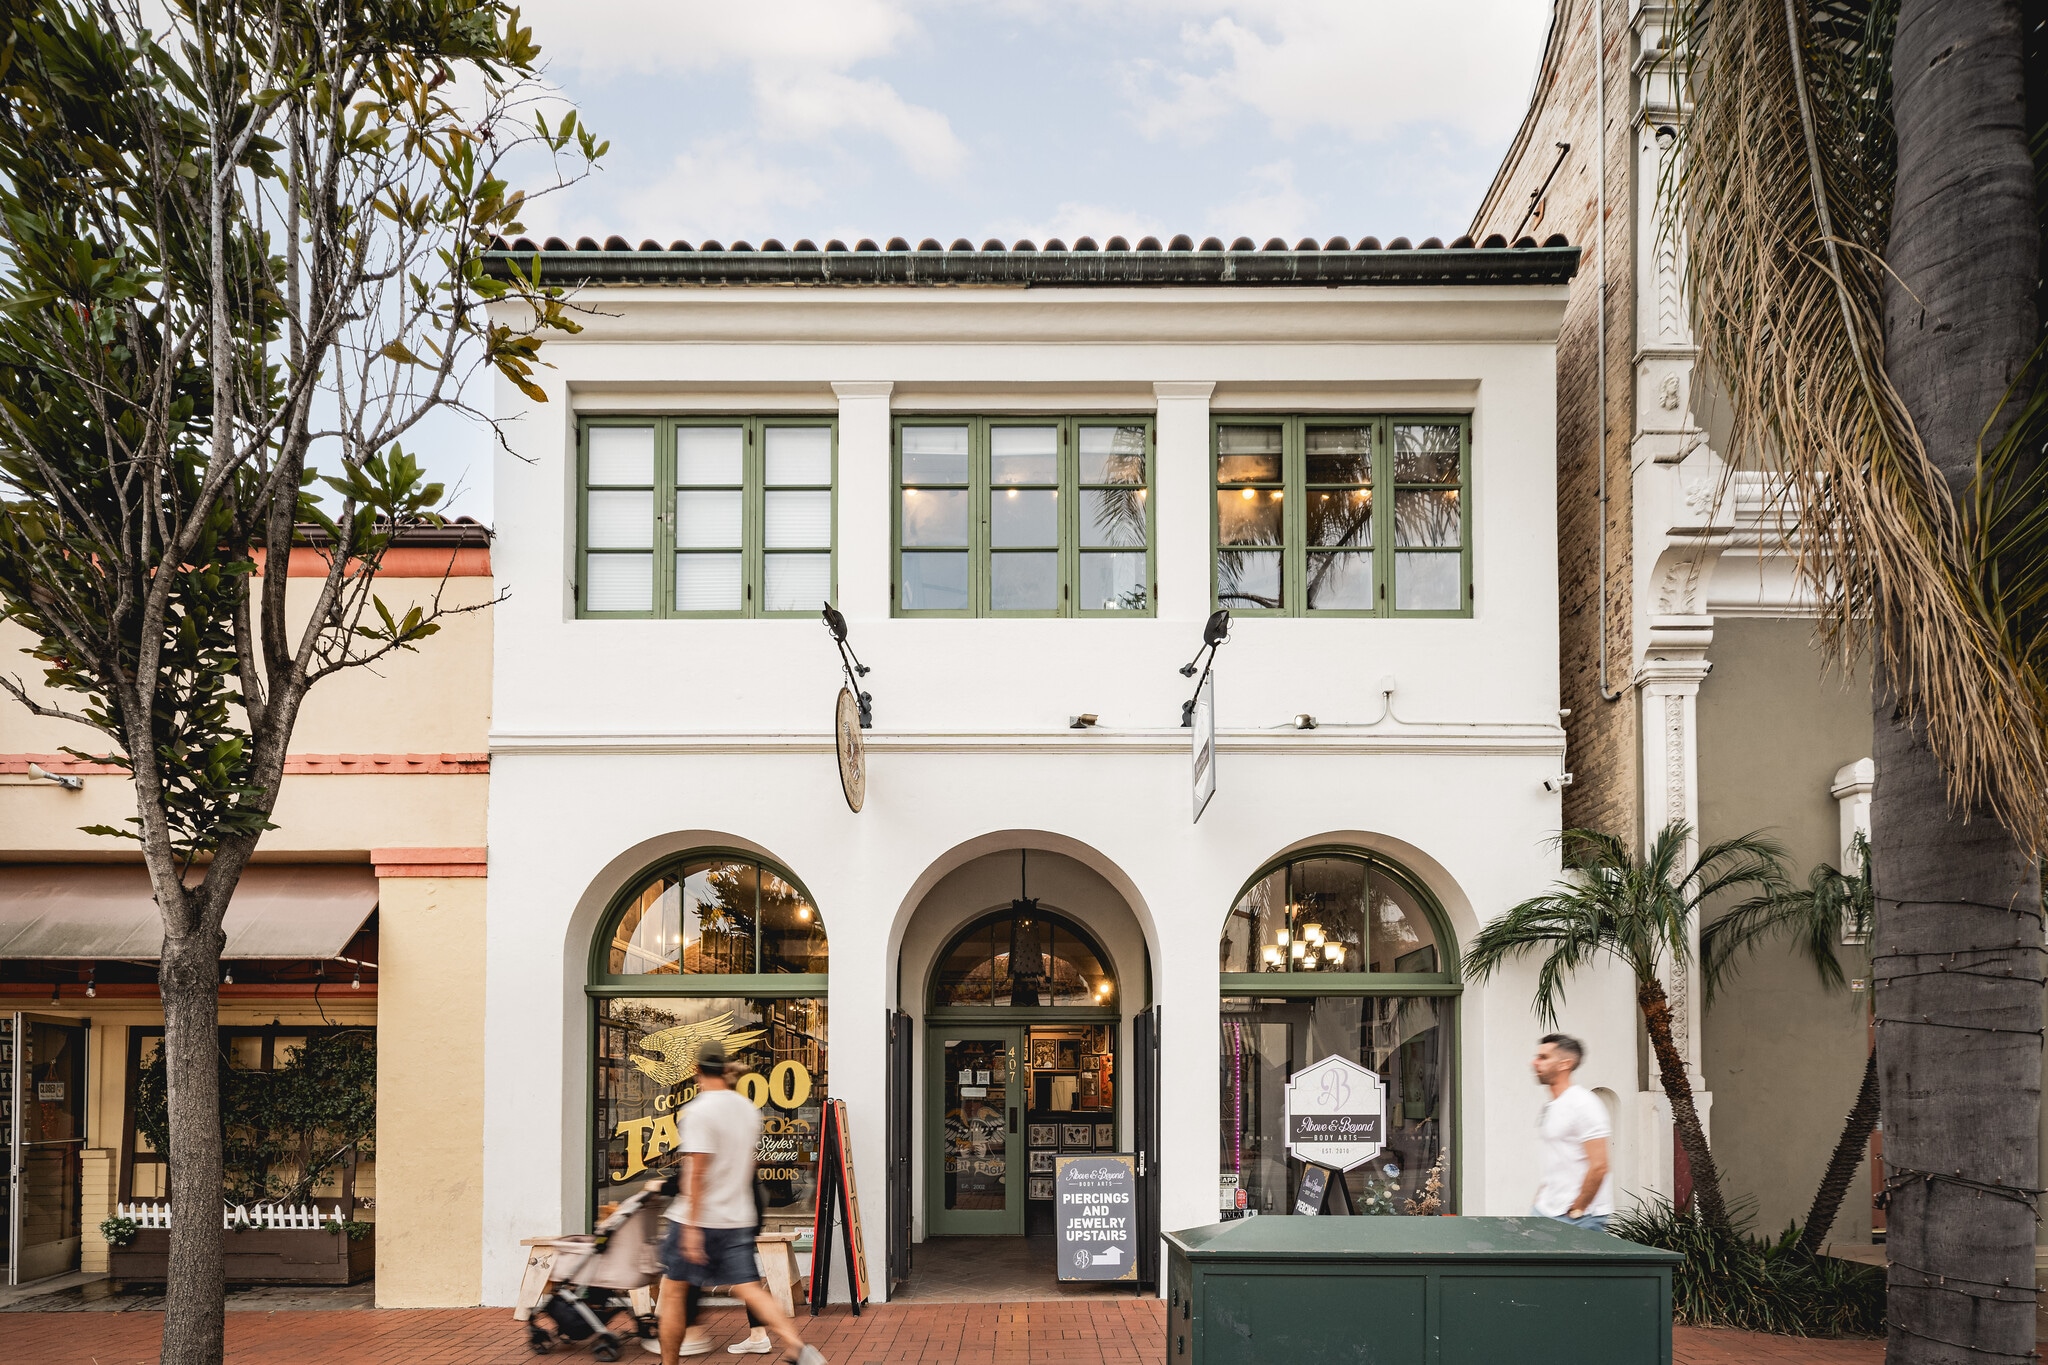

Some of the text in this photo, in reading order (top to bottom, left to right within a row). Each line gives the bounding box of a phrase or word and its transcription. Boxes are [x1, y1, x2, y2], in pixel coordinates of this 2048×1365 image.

[1008, 1046, 1017, 1084] 407
[654, 1084, 700, 1111] GOLDE
[1297, 1116, 1375, 1133] Above & Beyond
[756, 1136, 794, 1152] Styles
[752, 1151, 798, 1161] elcome
[758, 1168, 800, 1180] COLORS
[978, 1162, 1003, 1174] EAGL
[1066, 1167, 1125, 1181] Above & Beyond
[1062, 1193, 1130, 1204] PIERCINGS
[1083, 1205, 1109, 1216] AND
[1067, 1218, 1126, 1229] JEWELRY
[1066, 1230, 1127, 1241] UPSTAIRS
